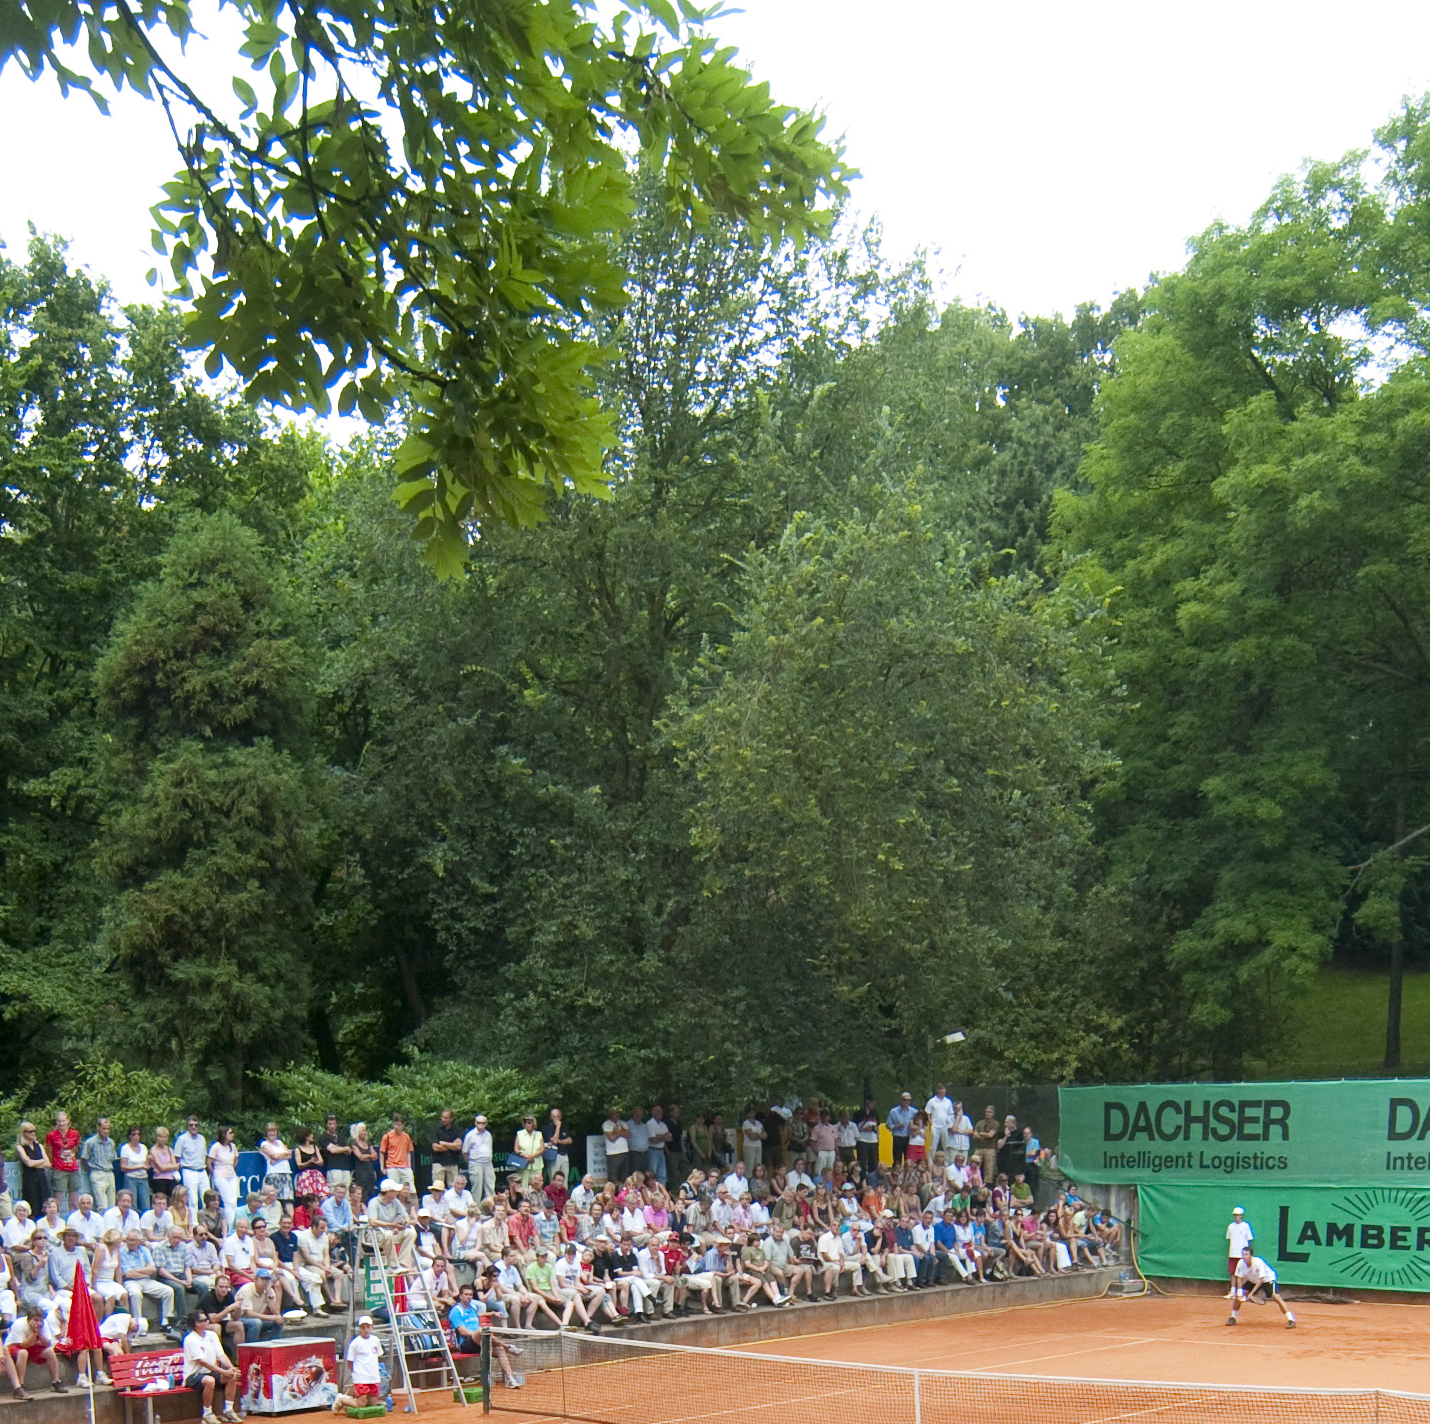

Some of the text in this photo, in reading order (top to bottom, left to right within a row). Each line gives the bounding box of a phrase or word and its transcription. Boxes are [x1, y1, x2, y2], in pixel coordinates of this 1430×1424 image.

[1103, 1099, 1291, 1142] DACHSER
[1103, 1150, 1288, 1174] Intelligent Logistics
